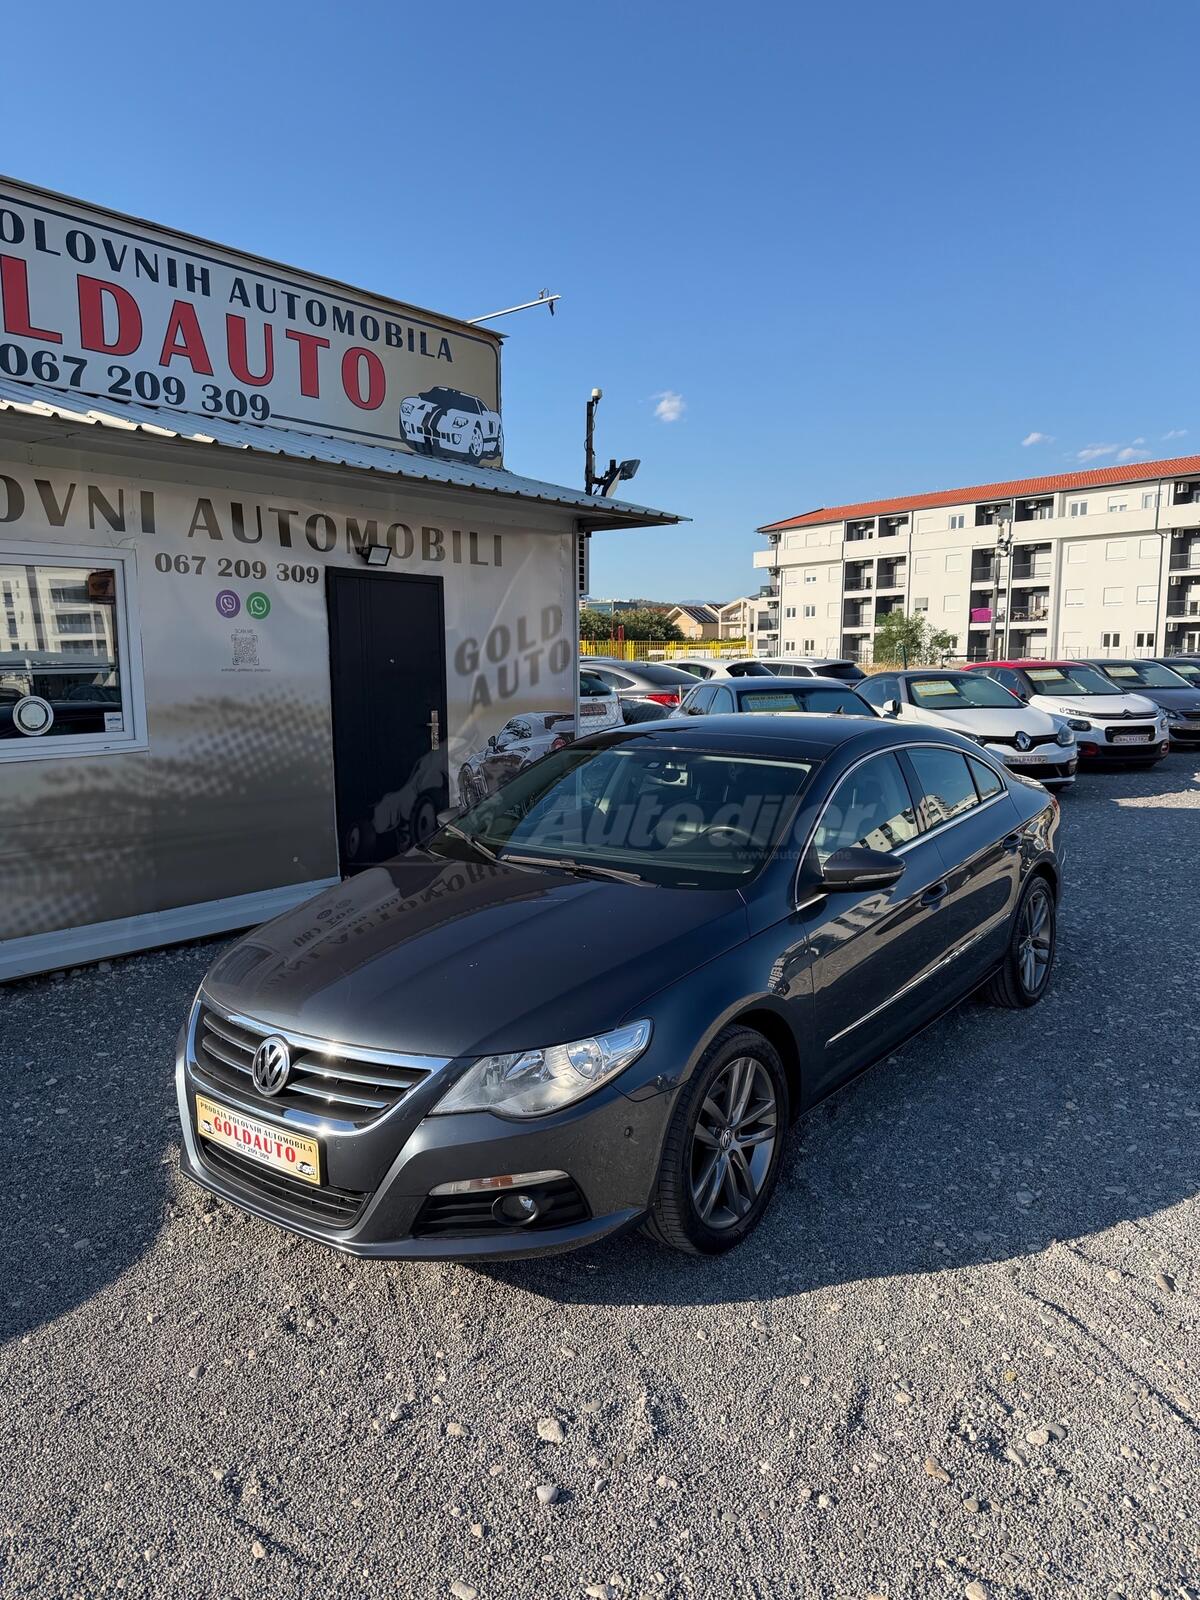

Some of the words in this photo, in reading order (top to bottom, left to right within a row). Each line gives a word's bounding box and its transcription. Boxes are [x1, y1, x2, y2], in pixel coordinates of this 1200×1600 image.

[0, 209, 211, 297] OLOVNIH
[228, 277, 453, 363] AUTOMOBILA
[0, 254, 387, 411] LDAUTO
[0, 343, 88, 388] 067
[107, 365, 186, 406] 209
[201, 384, 270, 421] 309
[154, 552, 206, 575] 067
[217, 558, 267, 579] 209
[276, 563, 320, 584] 309
[187, 497, 502, 567] AUTOMOBILI
[454, 604, 563, 676] GOLD
[470, 637, 571, 713] AUTO
[200, 1101, 227, 1120] PRODAJA
[228, 1113, 262, 1134] POLOVNIH
[263, 1129, 313, 1153] AUTOMOBILA
[213, 1116, 296, 1163] GOLDAUTO
